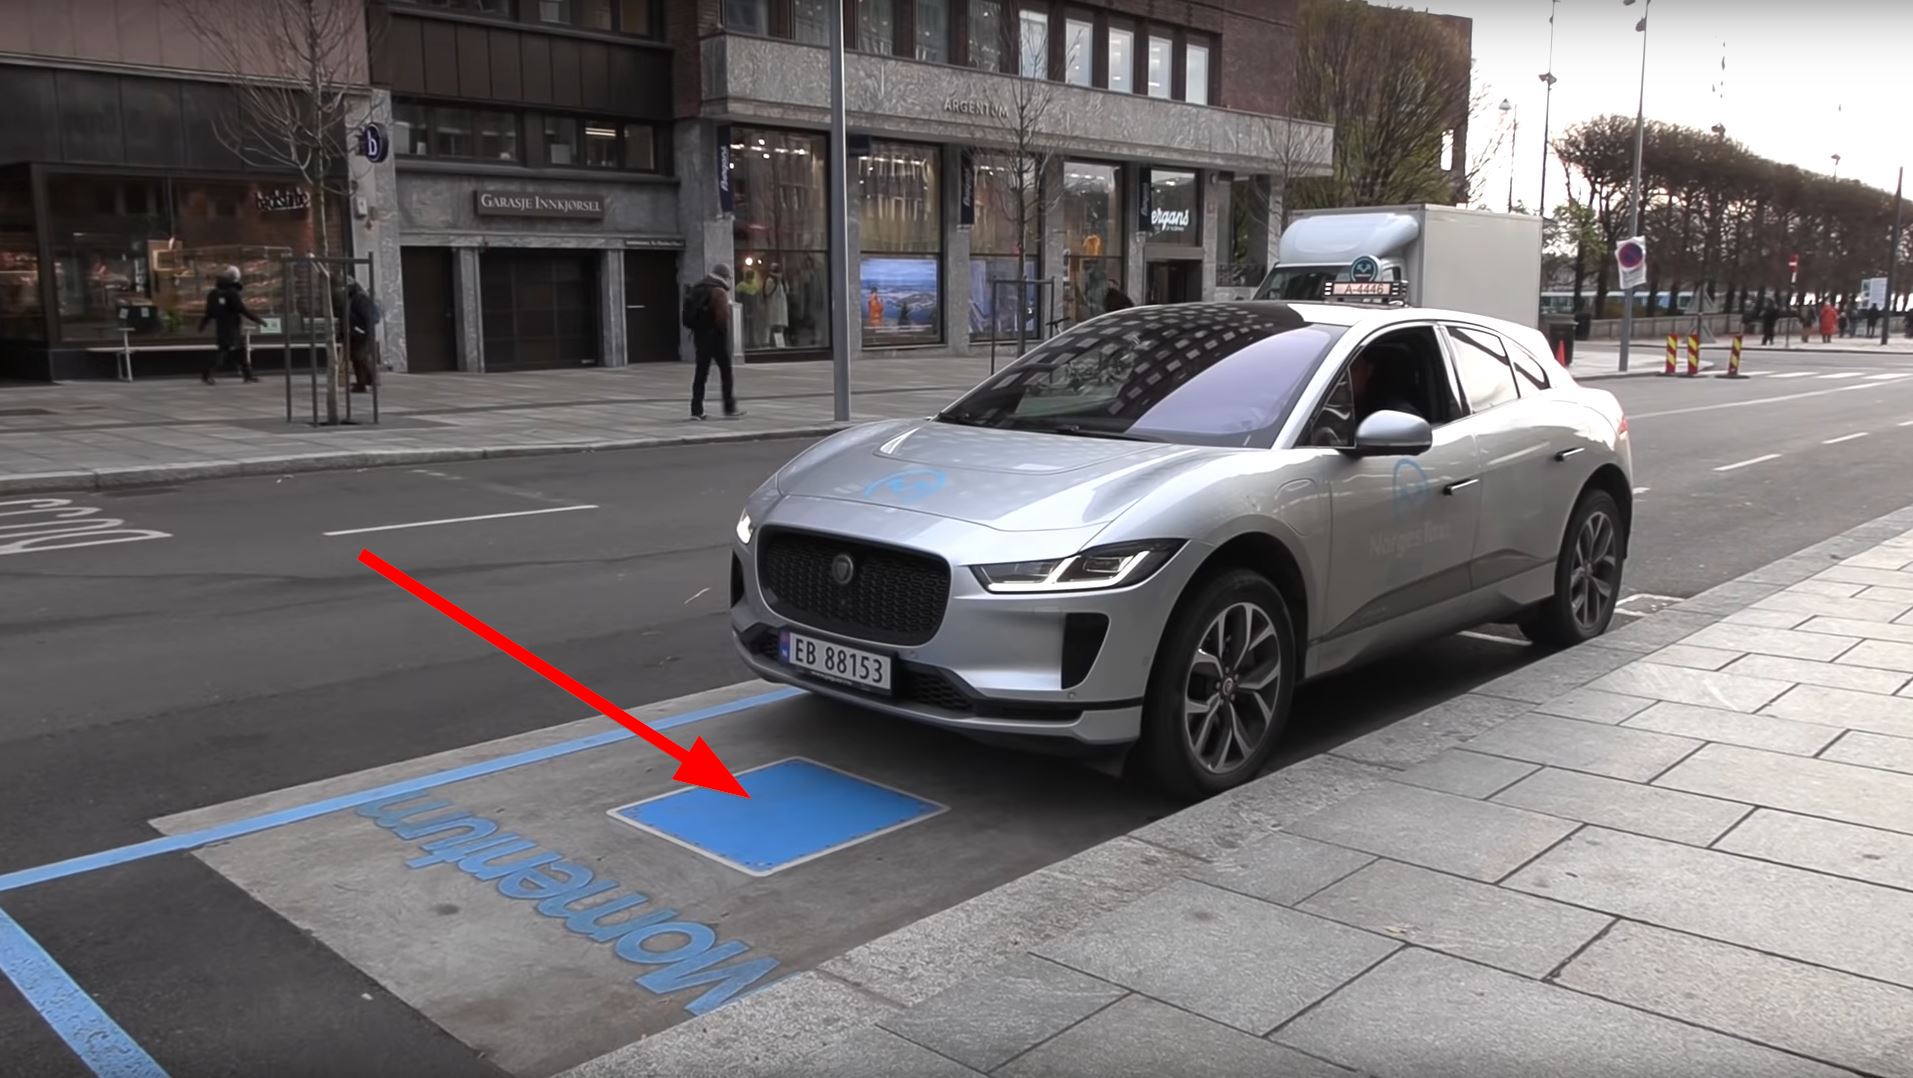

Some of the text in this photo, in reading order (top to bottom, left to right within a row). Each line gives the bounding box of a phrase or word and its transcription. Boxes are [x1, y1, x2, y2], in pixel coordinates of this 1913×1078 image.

[943, 98, 1009, 117] ARGENTUM
[480, 193, 533, 211] GARASJE
[1151, 207, 1189, 231] ergans
[795, 638, 816, 665] EB
[824, 646, 883, 683] 88153
